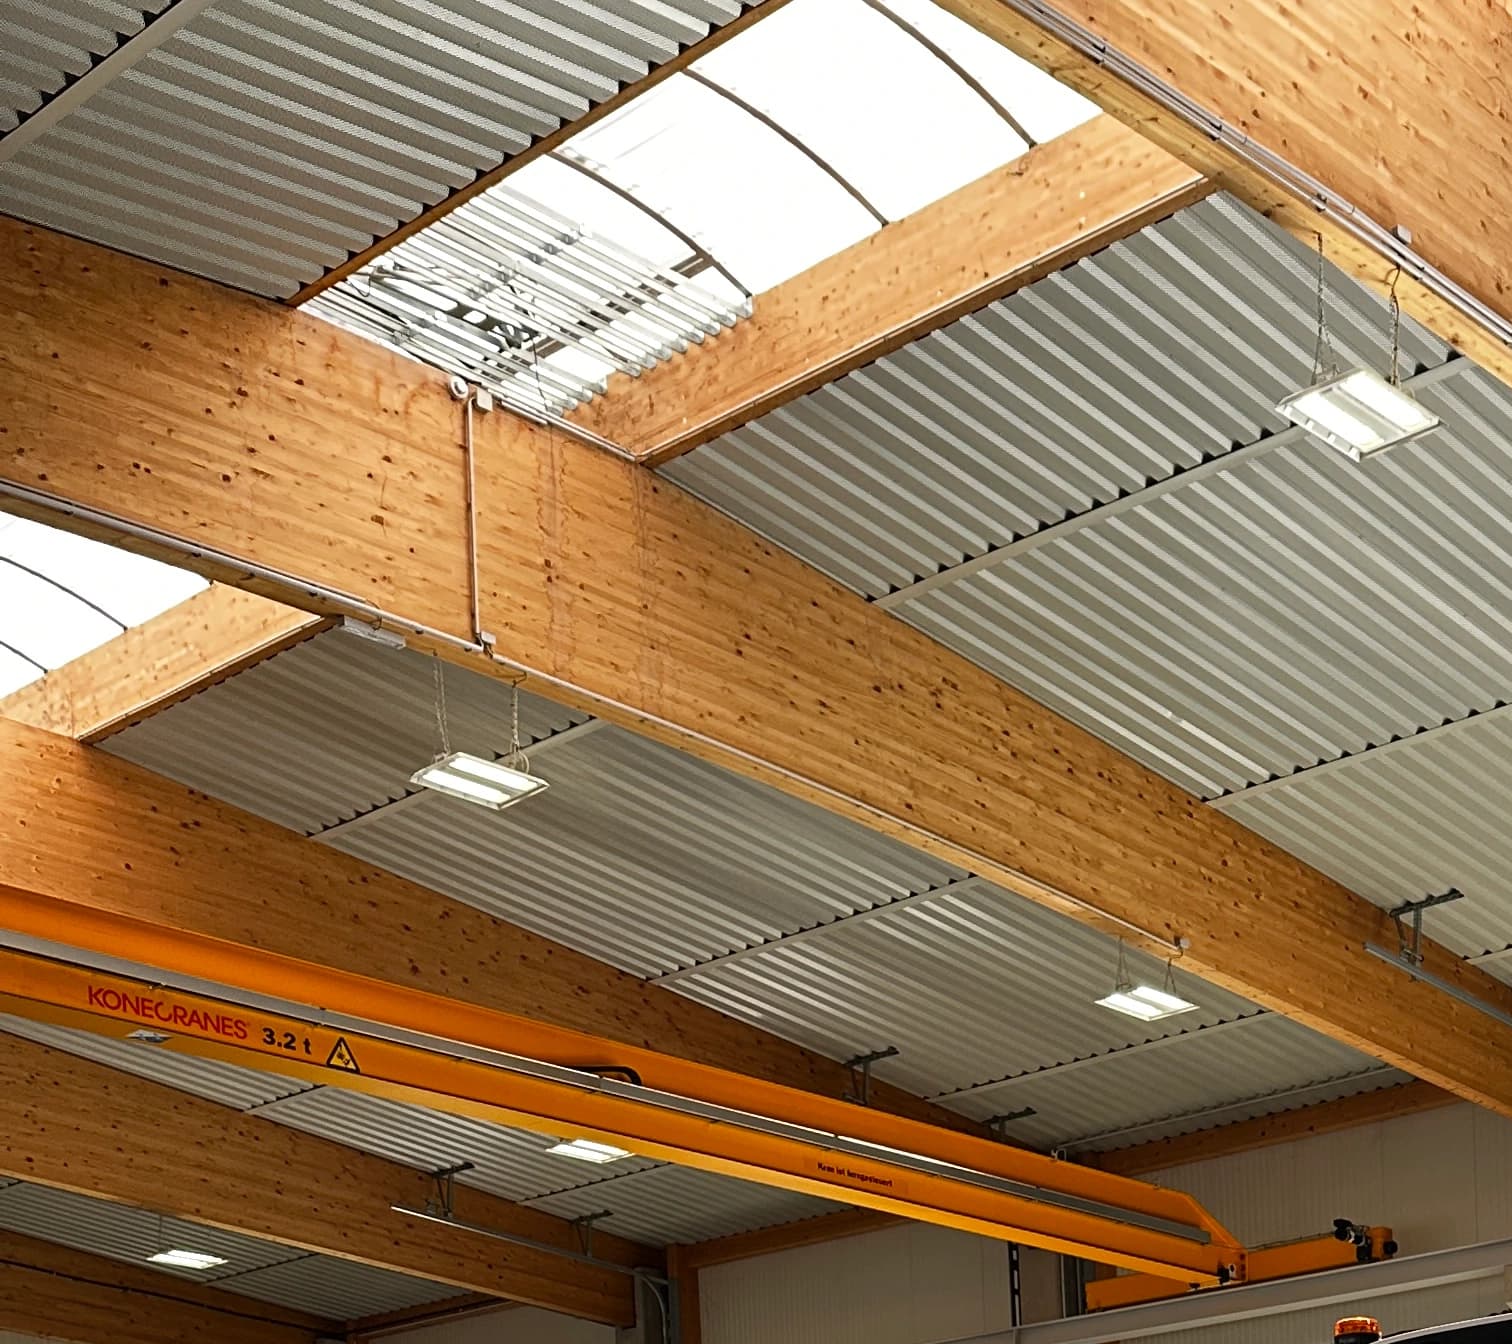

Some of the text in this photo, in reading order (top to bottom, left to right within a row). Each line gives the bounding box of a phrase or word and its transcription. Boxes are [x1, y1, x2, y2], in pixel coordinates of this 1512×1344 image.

[87, 985, 248, 1040] KONECRANES
[262, 1027, 312, 1054] 3.2 t
